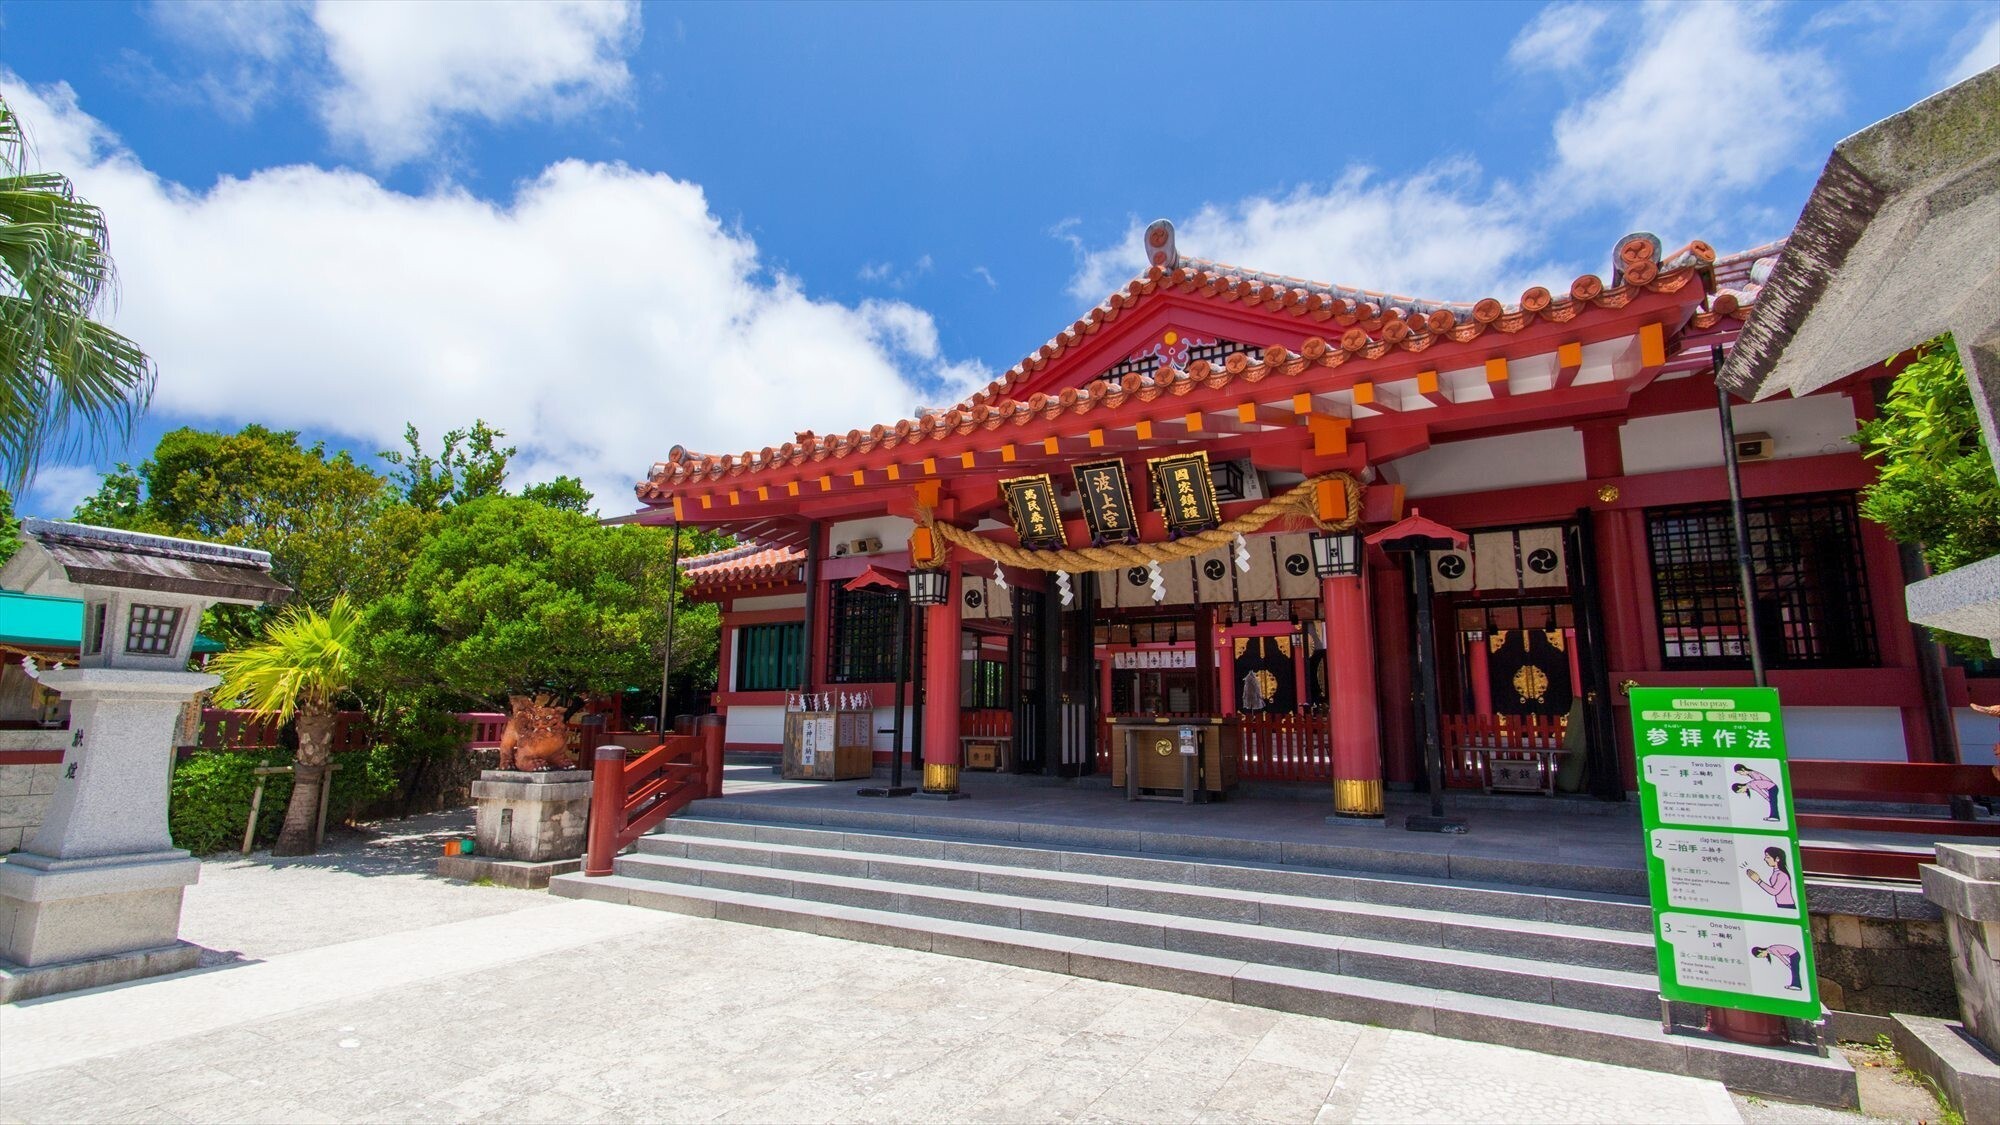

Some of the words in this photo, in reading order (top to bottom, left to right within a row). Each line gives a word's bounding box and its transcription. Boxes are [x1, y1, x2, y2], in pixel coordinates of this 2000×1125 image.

[1093, 471, 1119, 528] 波上宮
[1647, 728, 1771, 748] 参拝作法
[1648, 765, 1653, 774] 1
[1655, 838, 1663, 849] 2
[1668, 843, 1698, 853] 二拍手
[1664, 923, 1672, 932] 3
